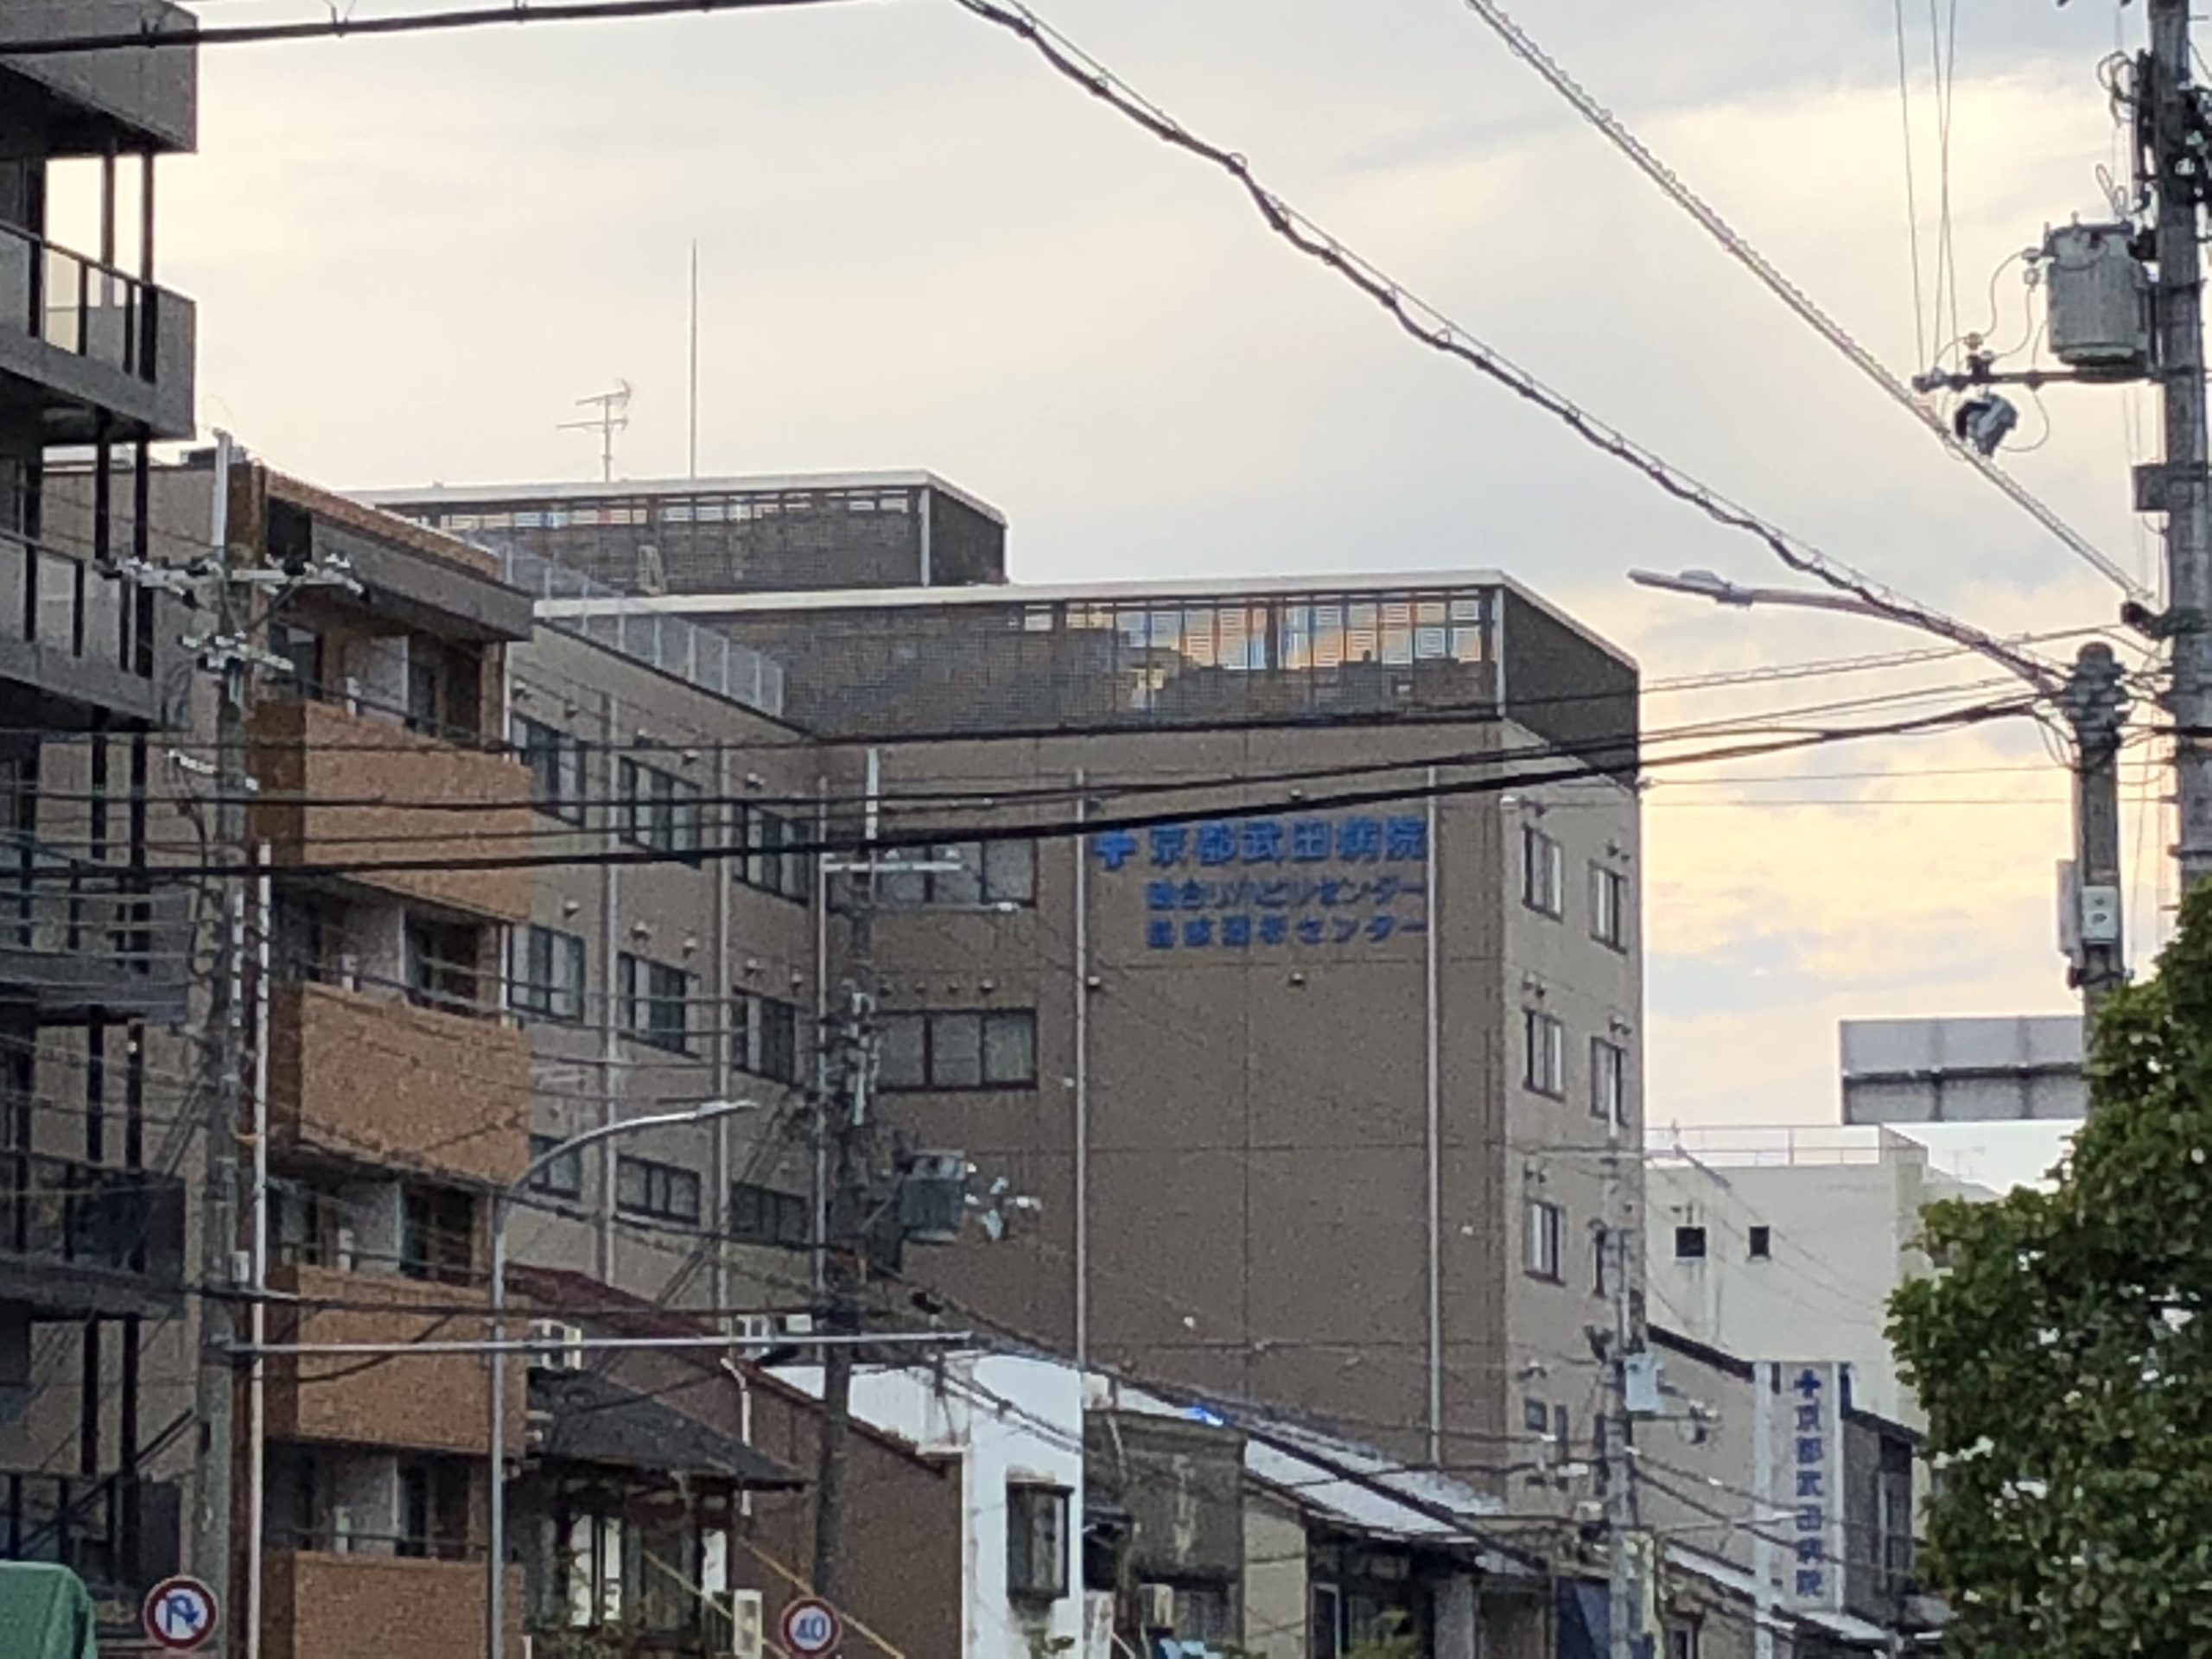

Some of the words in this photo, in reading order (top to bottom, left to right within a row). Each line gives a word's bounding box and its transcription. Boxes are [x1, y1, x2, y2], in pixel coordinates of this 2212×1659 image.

[1148, 816, 1426, 867] 京都武田病院
[795, 1615, 826, 1642] 40
